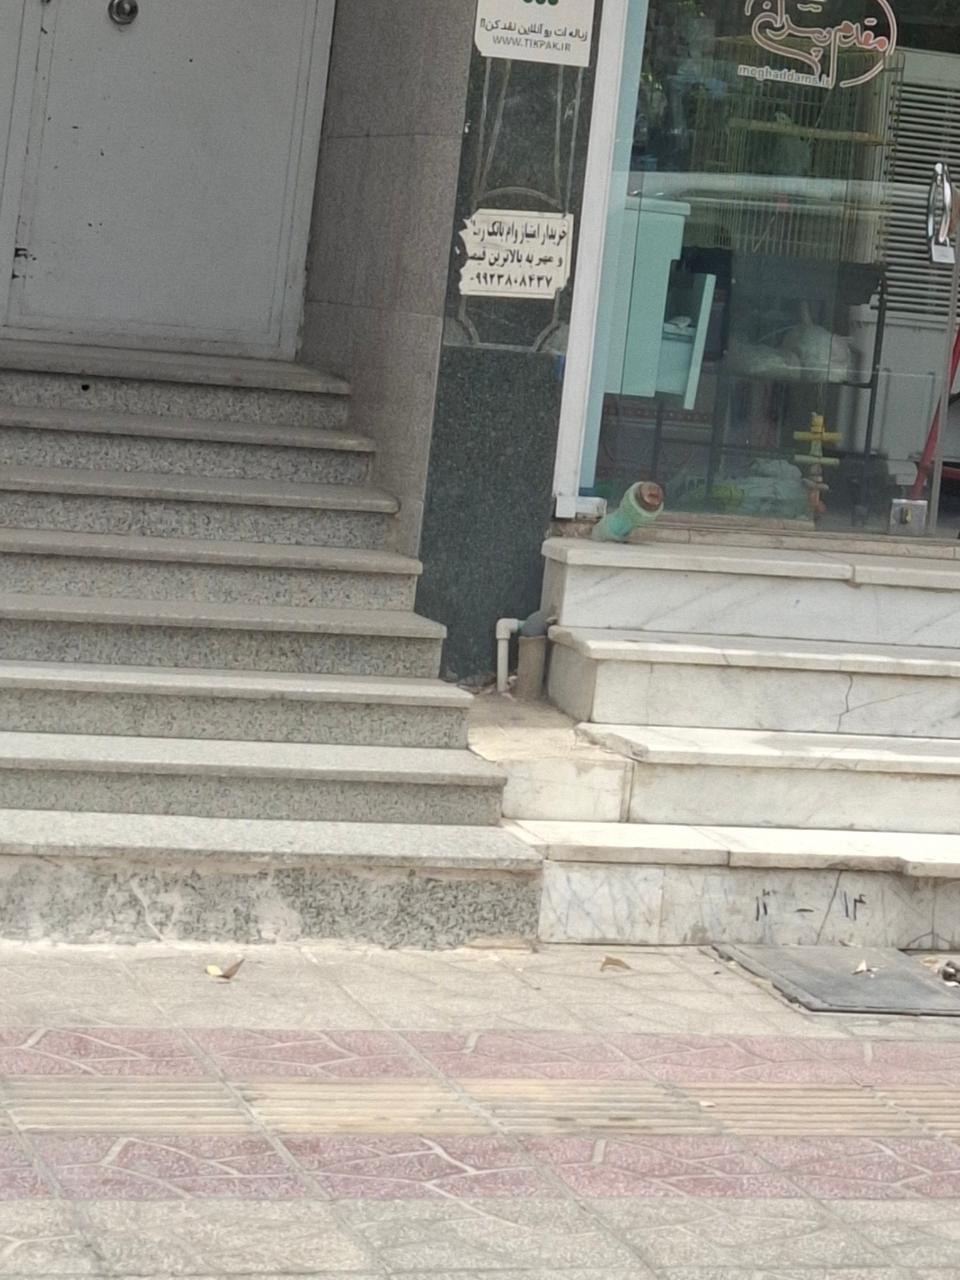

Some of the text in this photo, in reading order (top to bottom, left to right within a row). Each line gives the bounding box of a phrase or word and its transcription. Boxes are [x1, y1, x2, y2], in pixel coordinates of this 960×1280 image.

[505, 223, 518, 244] وام
[519, 223, 540, 245] امتیاز
[541, 222, 568, 247] خریدار
[488, 249, 523, 268] بالاترین
